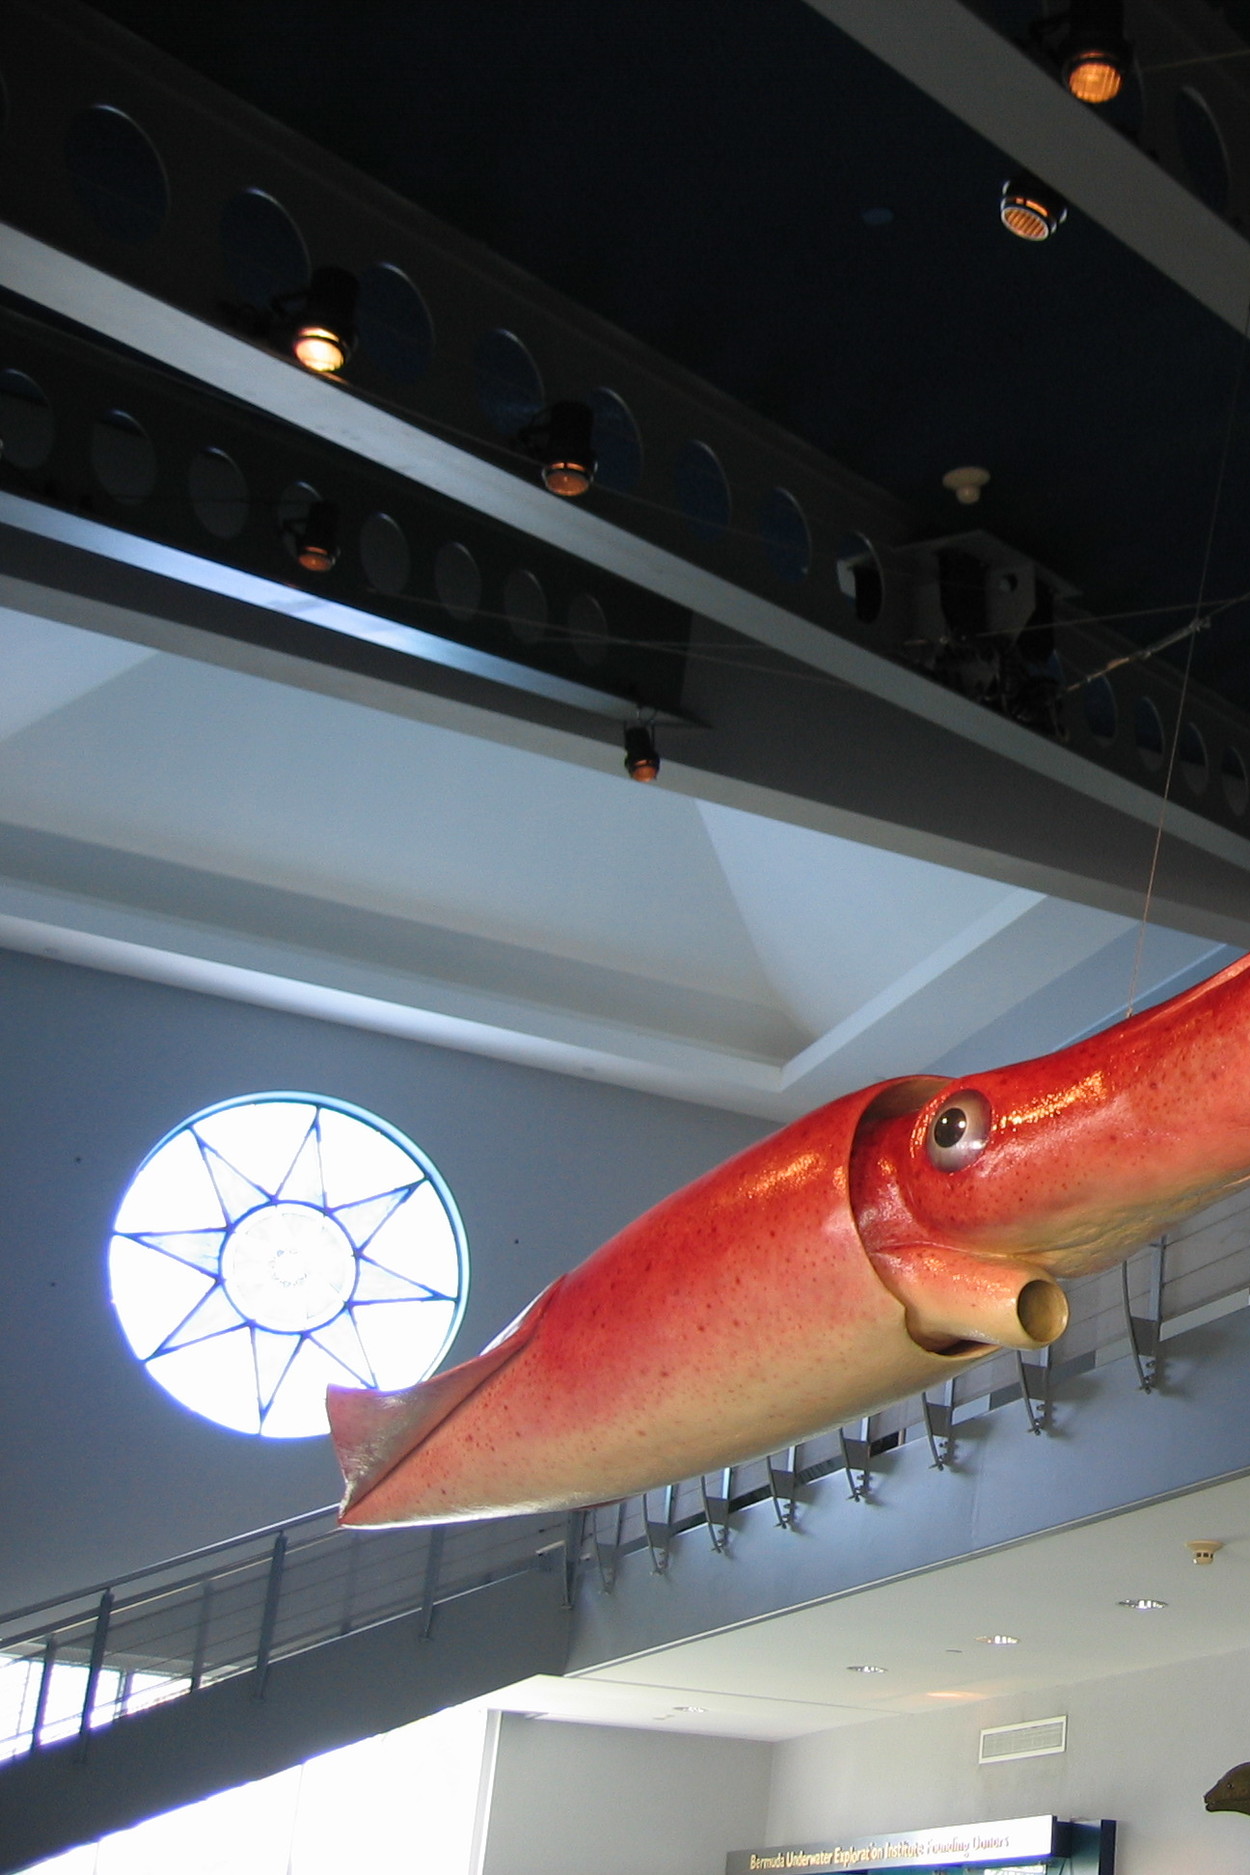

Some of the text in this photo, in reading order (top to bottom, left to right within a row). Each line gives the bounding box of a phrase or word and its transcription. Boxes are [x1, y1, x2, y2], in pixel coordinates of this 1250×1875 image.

[750, 1853, 785, 1869] Bermuda
[786, 1850, 833, 1867] Underwater
[834, 1843, 883, 1867] Exploration
[884, 1841, 924, 1861] Institute
